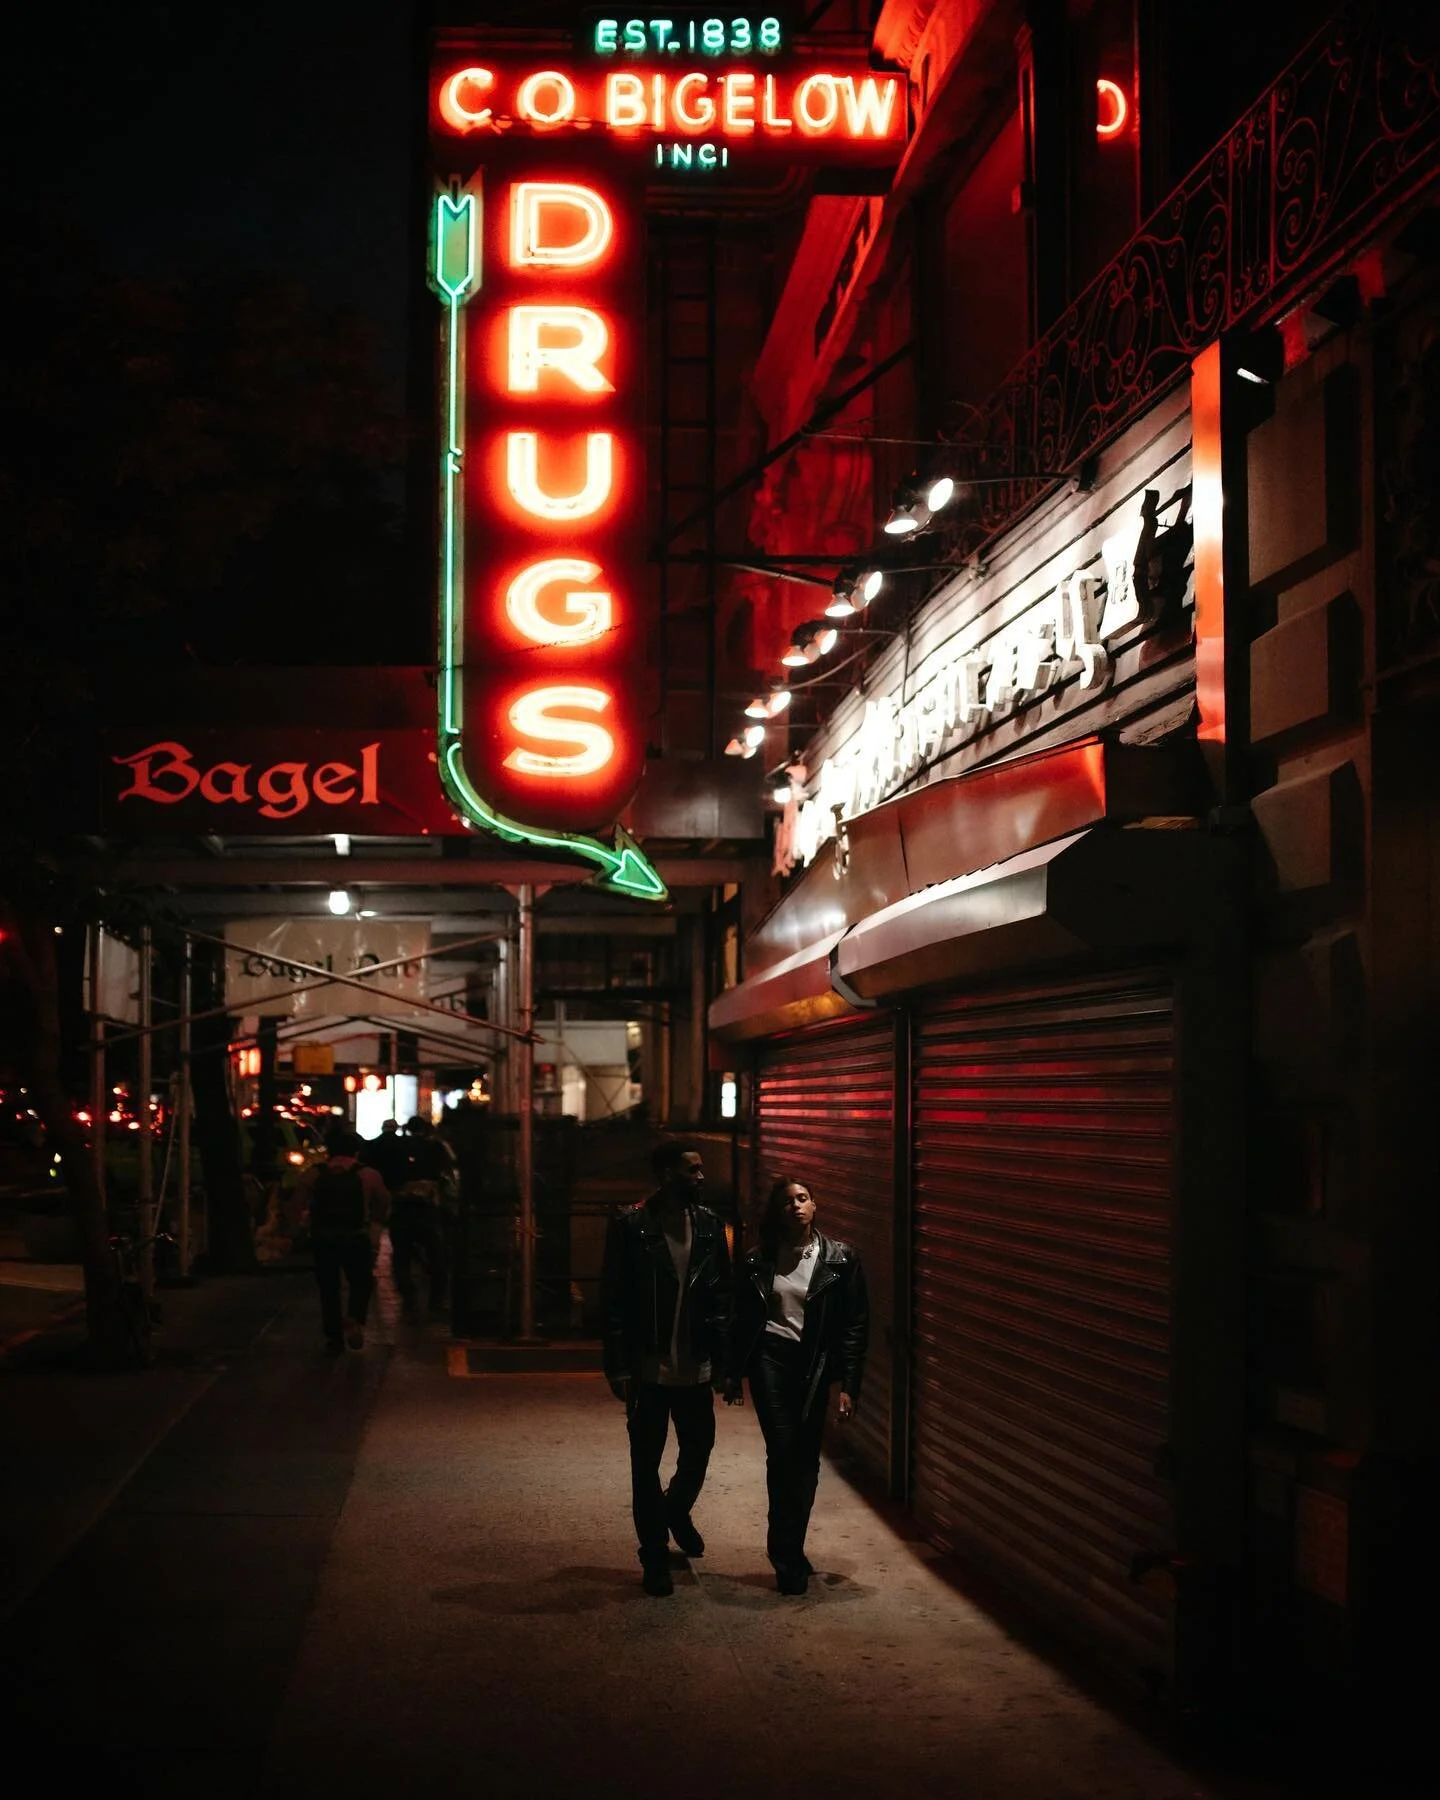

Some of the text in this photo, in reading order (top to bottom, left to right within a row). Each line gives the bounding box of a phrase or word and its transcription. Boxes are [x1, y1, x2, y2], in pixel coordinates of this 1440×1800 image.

[606, 72, 896, 136] BIGELOW
[502, 181, 617, 778] DRUGS
[112, 741, 381, 818] Bagel
